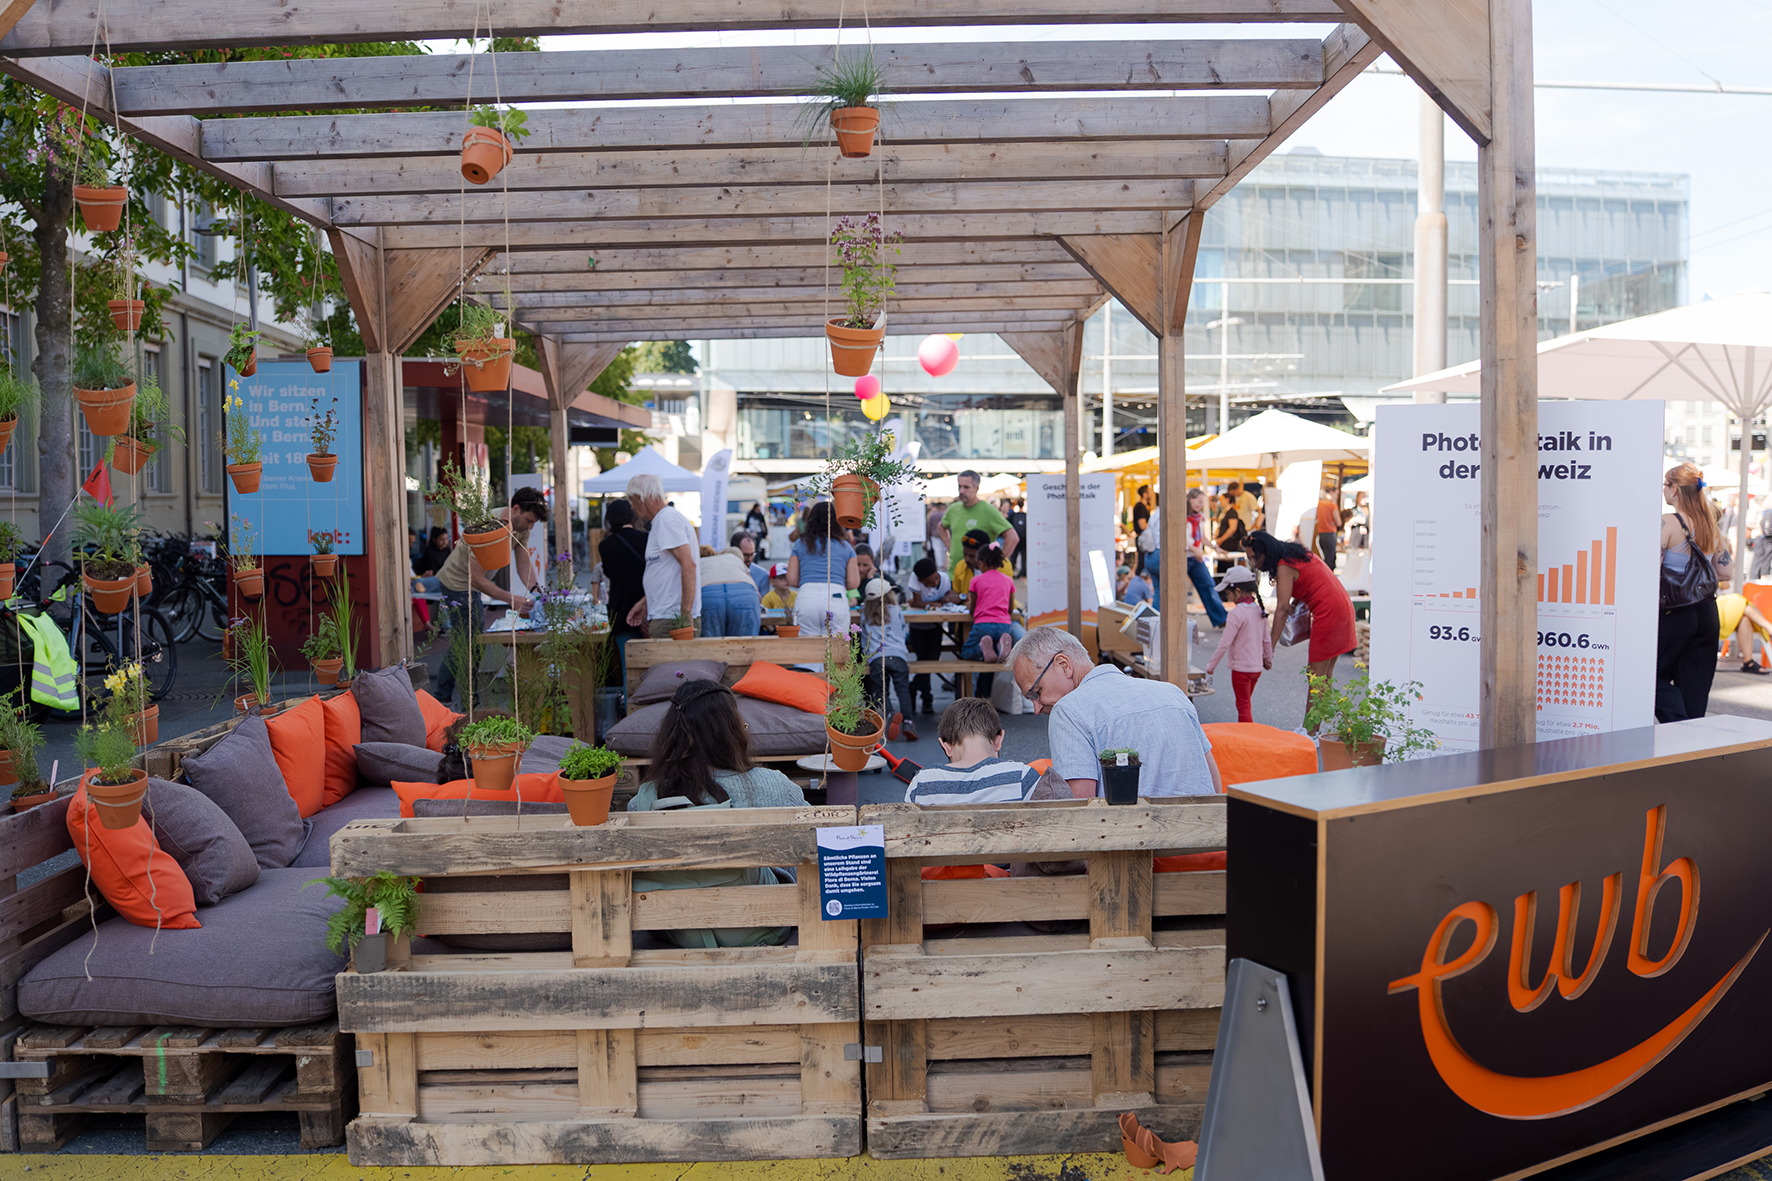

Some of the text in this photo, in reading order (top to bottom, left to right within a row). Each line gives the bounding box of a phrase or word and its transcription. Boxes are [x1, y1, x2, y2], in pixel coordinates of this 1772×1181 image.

[248, 385, 326, 397] Wir sitzen
[249, 400, 309, 412] in Bern.
[250, 415, 280, 427] Und
[1589, 431, 1612, 451] in
[1439, 460, 1592, 480] der weiz
[1430, 625, 1470, 641] 93.6
[1537, 631, 1590, 648] 960.6
[1387, 804, 1770, 1120] ewb
